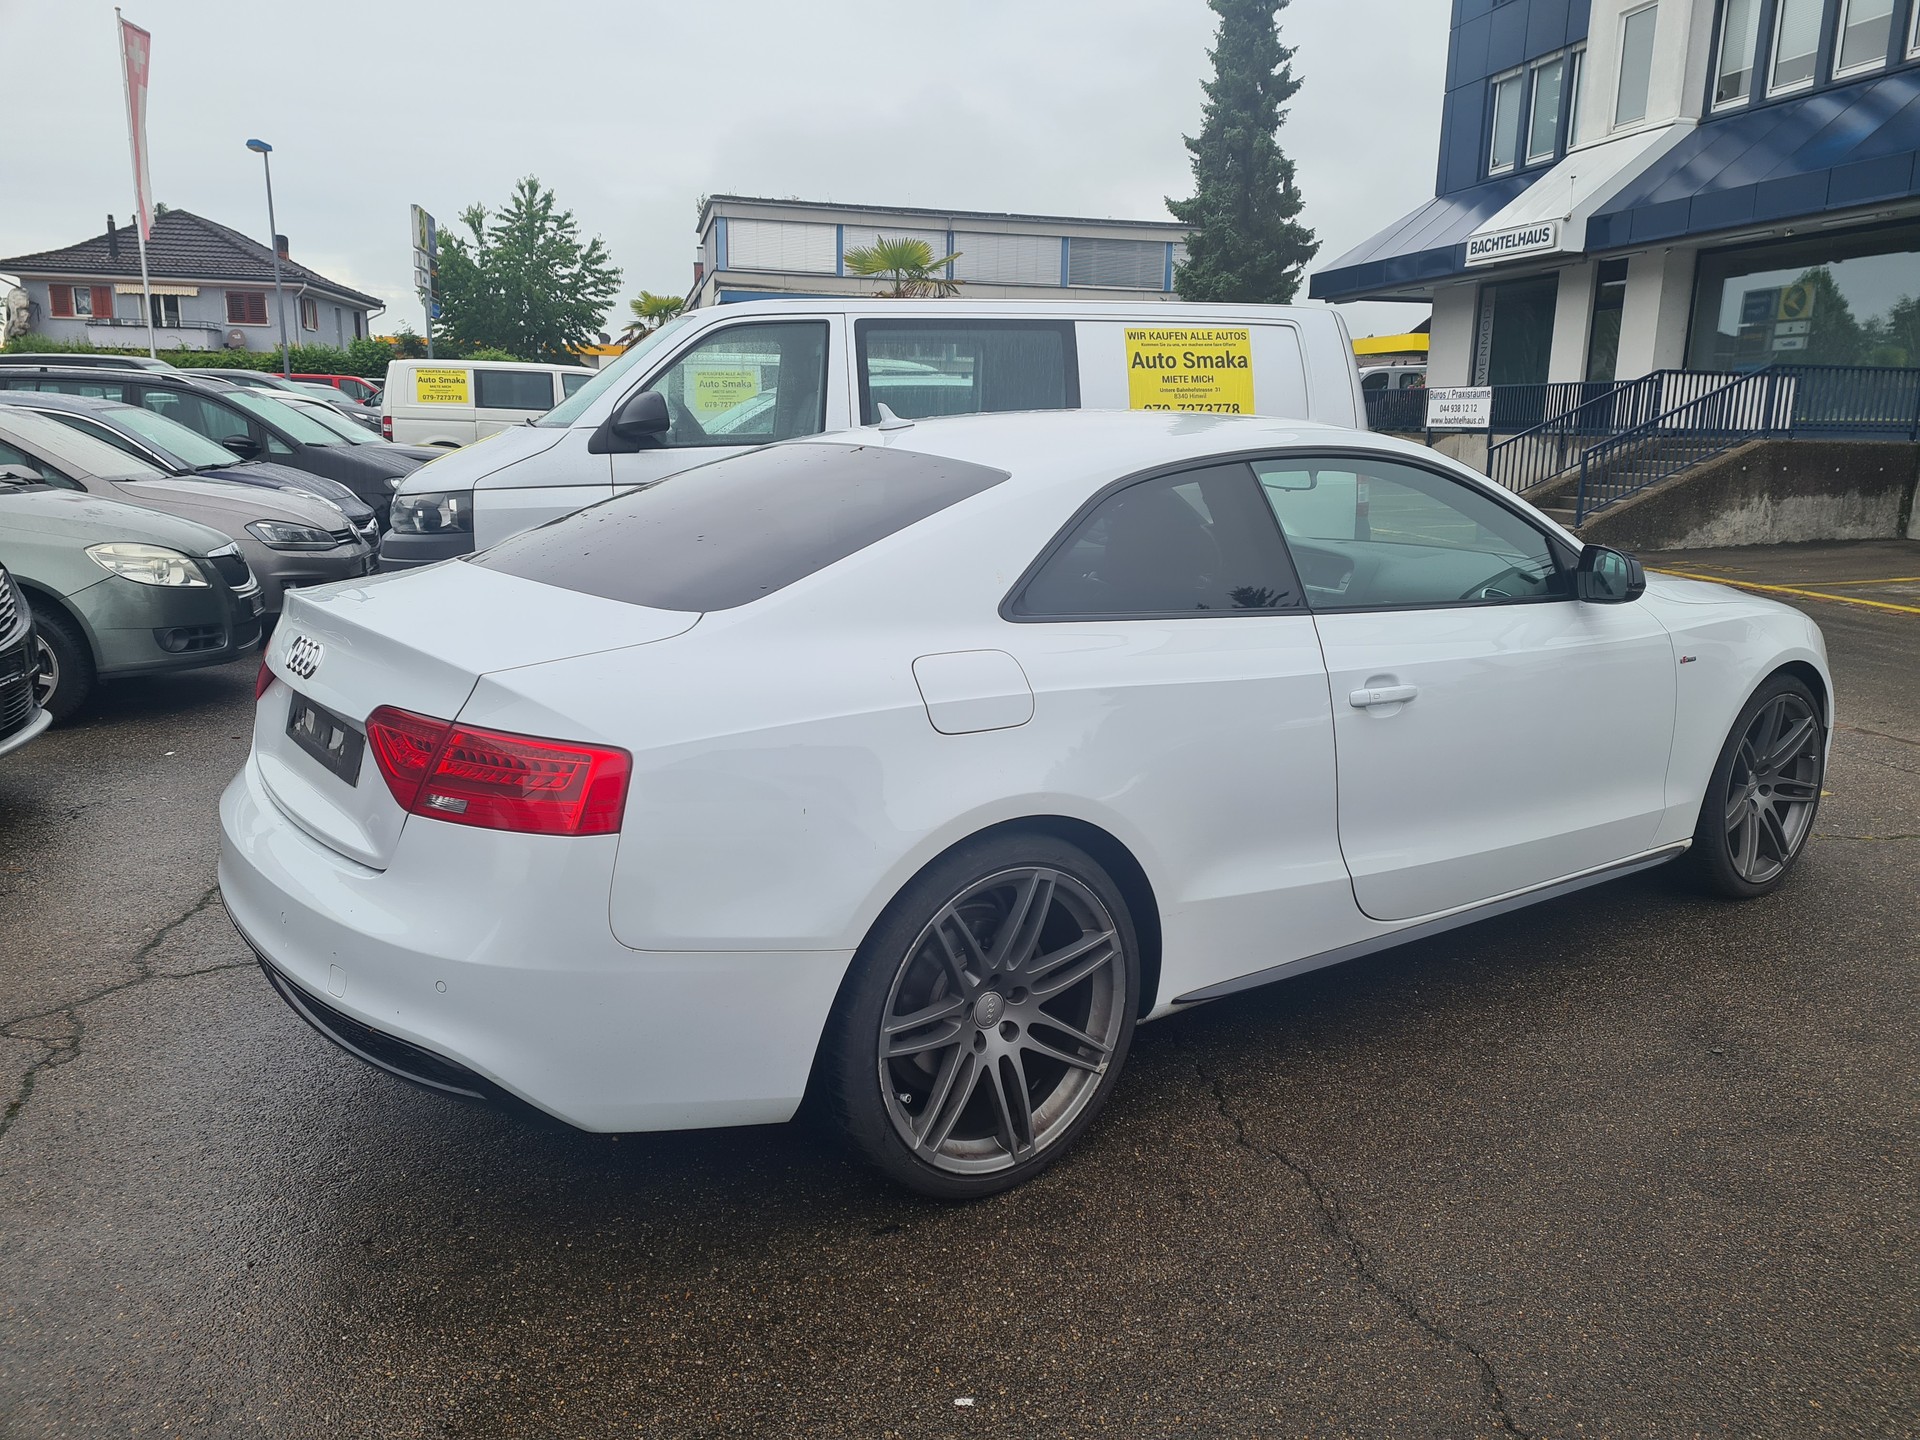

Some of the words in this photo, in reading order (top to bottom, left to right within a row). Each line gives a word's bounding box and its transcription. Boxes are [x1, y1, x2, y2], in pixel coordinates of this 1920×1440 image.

[1470, 227, 1550, 256] BACHTELHAUS
[1127, 331, 1147, 340] WIR
[1149, 331, 1188, 340] KAUFEN
[1190, 331, 1213, 340] ALLE
[1215, 331, 1247, 341] AUTOS
[1131, 351, 1177, 369] Auto
[1182, 350, 1248, 369] Smaka
[438, 376, 466, 384] Smaka
[699, 380, 720, 388] Auto
[721, 379, 752, 388] Smaka
[1161, 375, 1189, 383] MIETE
[1191, 375, 1214, 383] MICH
[1430, 389, 1447, 399] Büros
[1451, 388, 1491, 399] Praxisräume
[1439, 404, 1450, 413] 044
[1450, 404, 1461, 413] 938
[1462, 403, 1469, 413] 12
[1470, 403, 1478, 413] 12
[1430, 415, 1485, 425] www.bachtelhaus.ch
